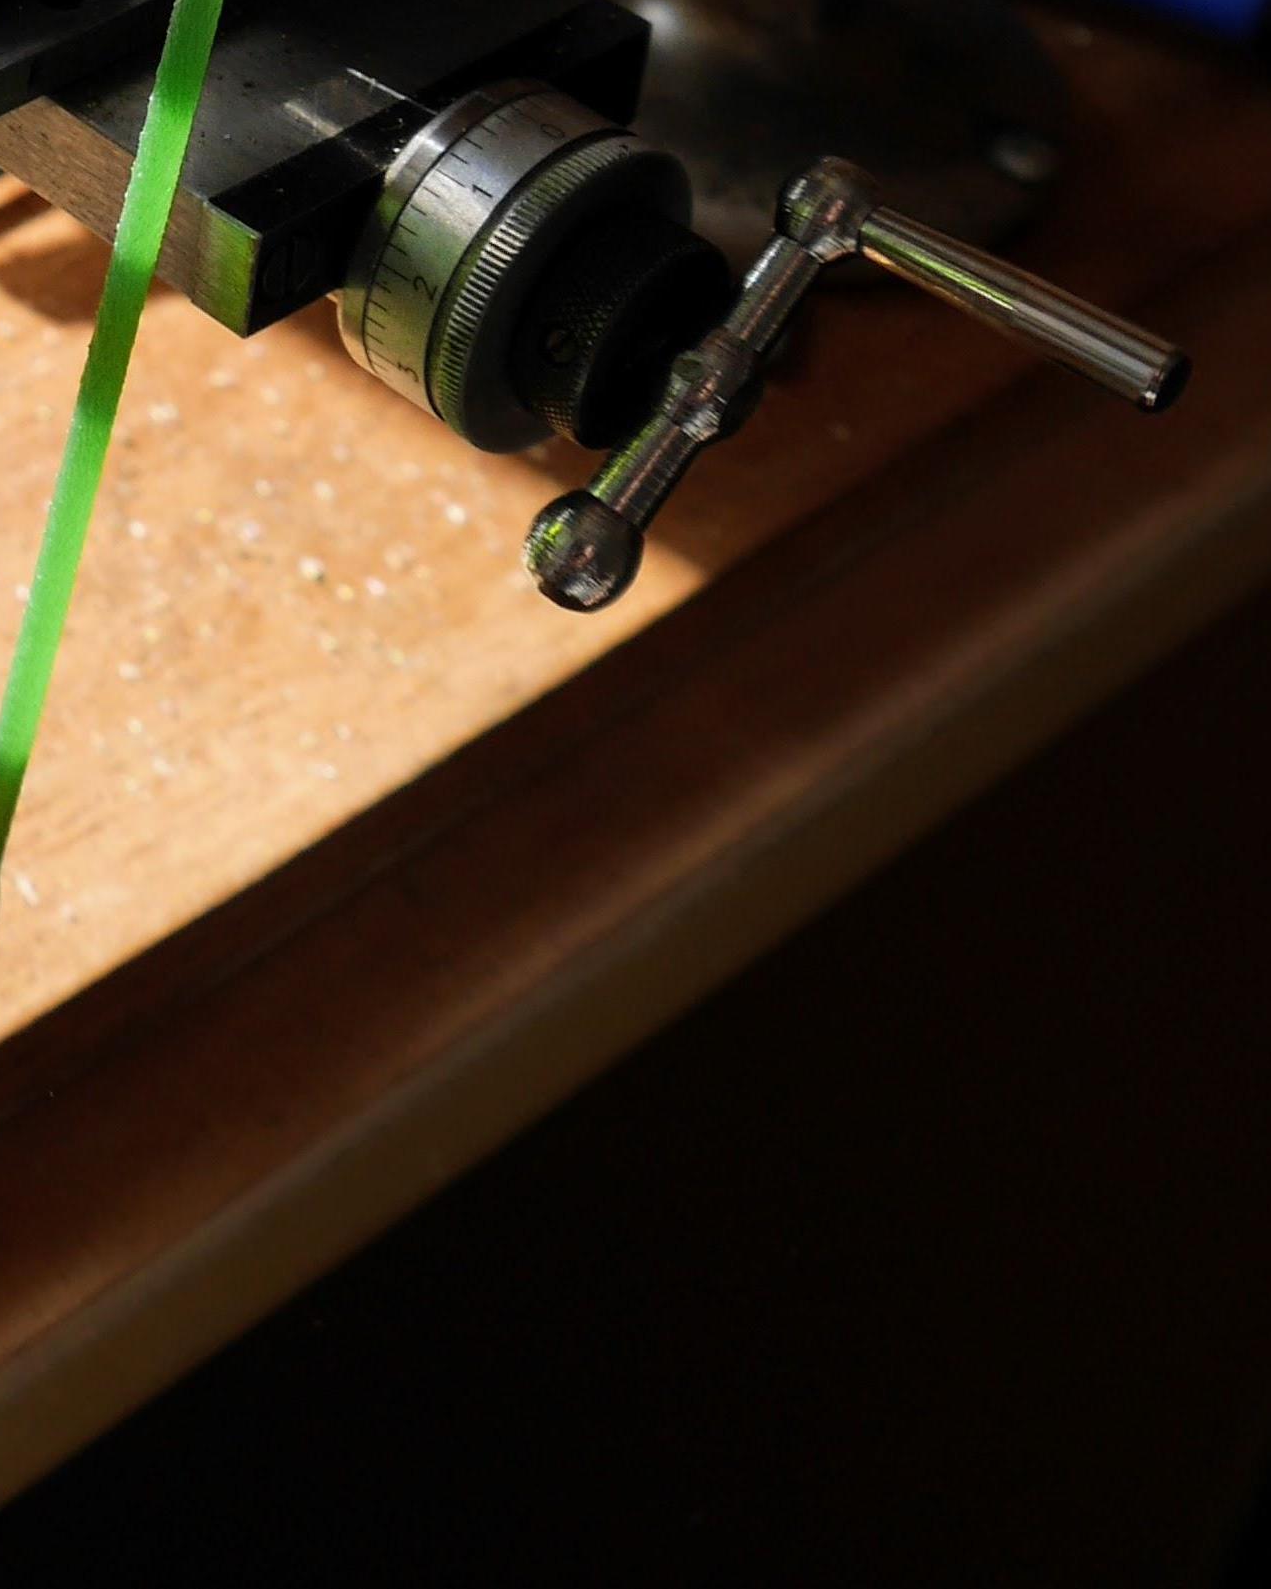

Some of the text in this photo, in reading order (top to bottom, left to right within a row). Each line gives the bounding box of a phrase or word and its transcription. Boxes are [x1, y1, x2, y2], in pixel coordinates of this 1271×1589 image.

[472, 183, 493, 198] 1
[413, 276, 438, 301] 2
[397, 361, 419, 384] 3
